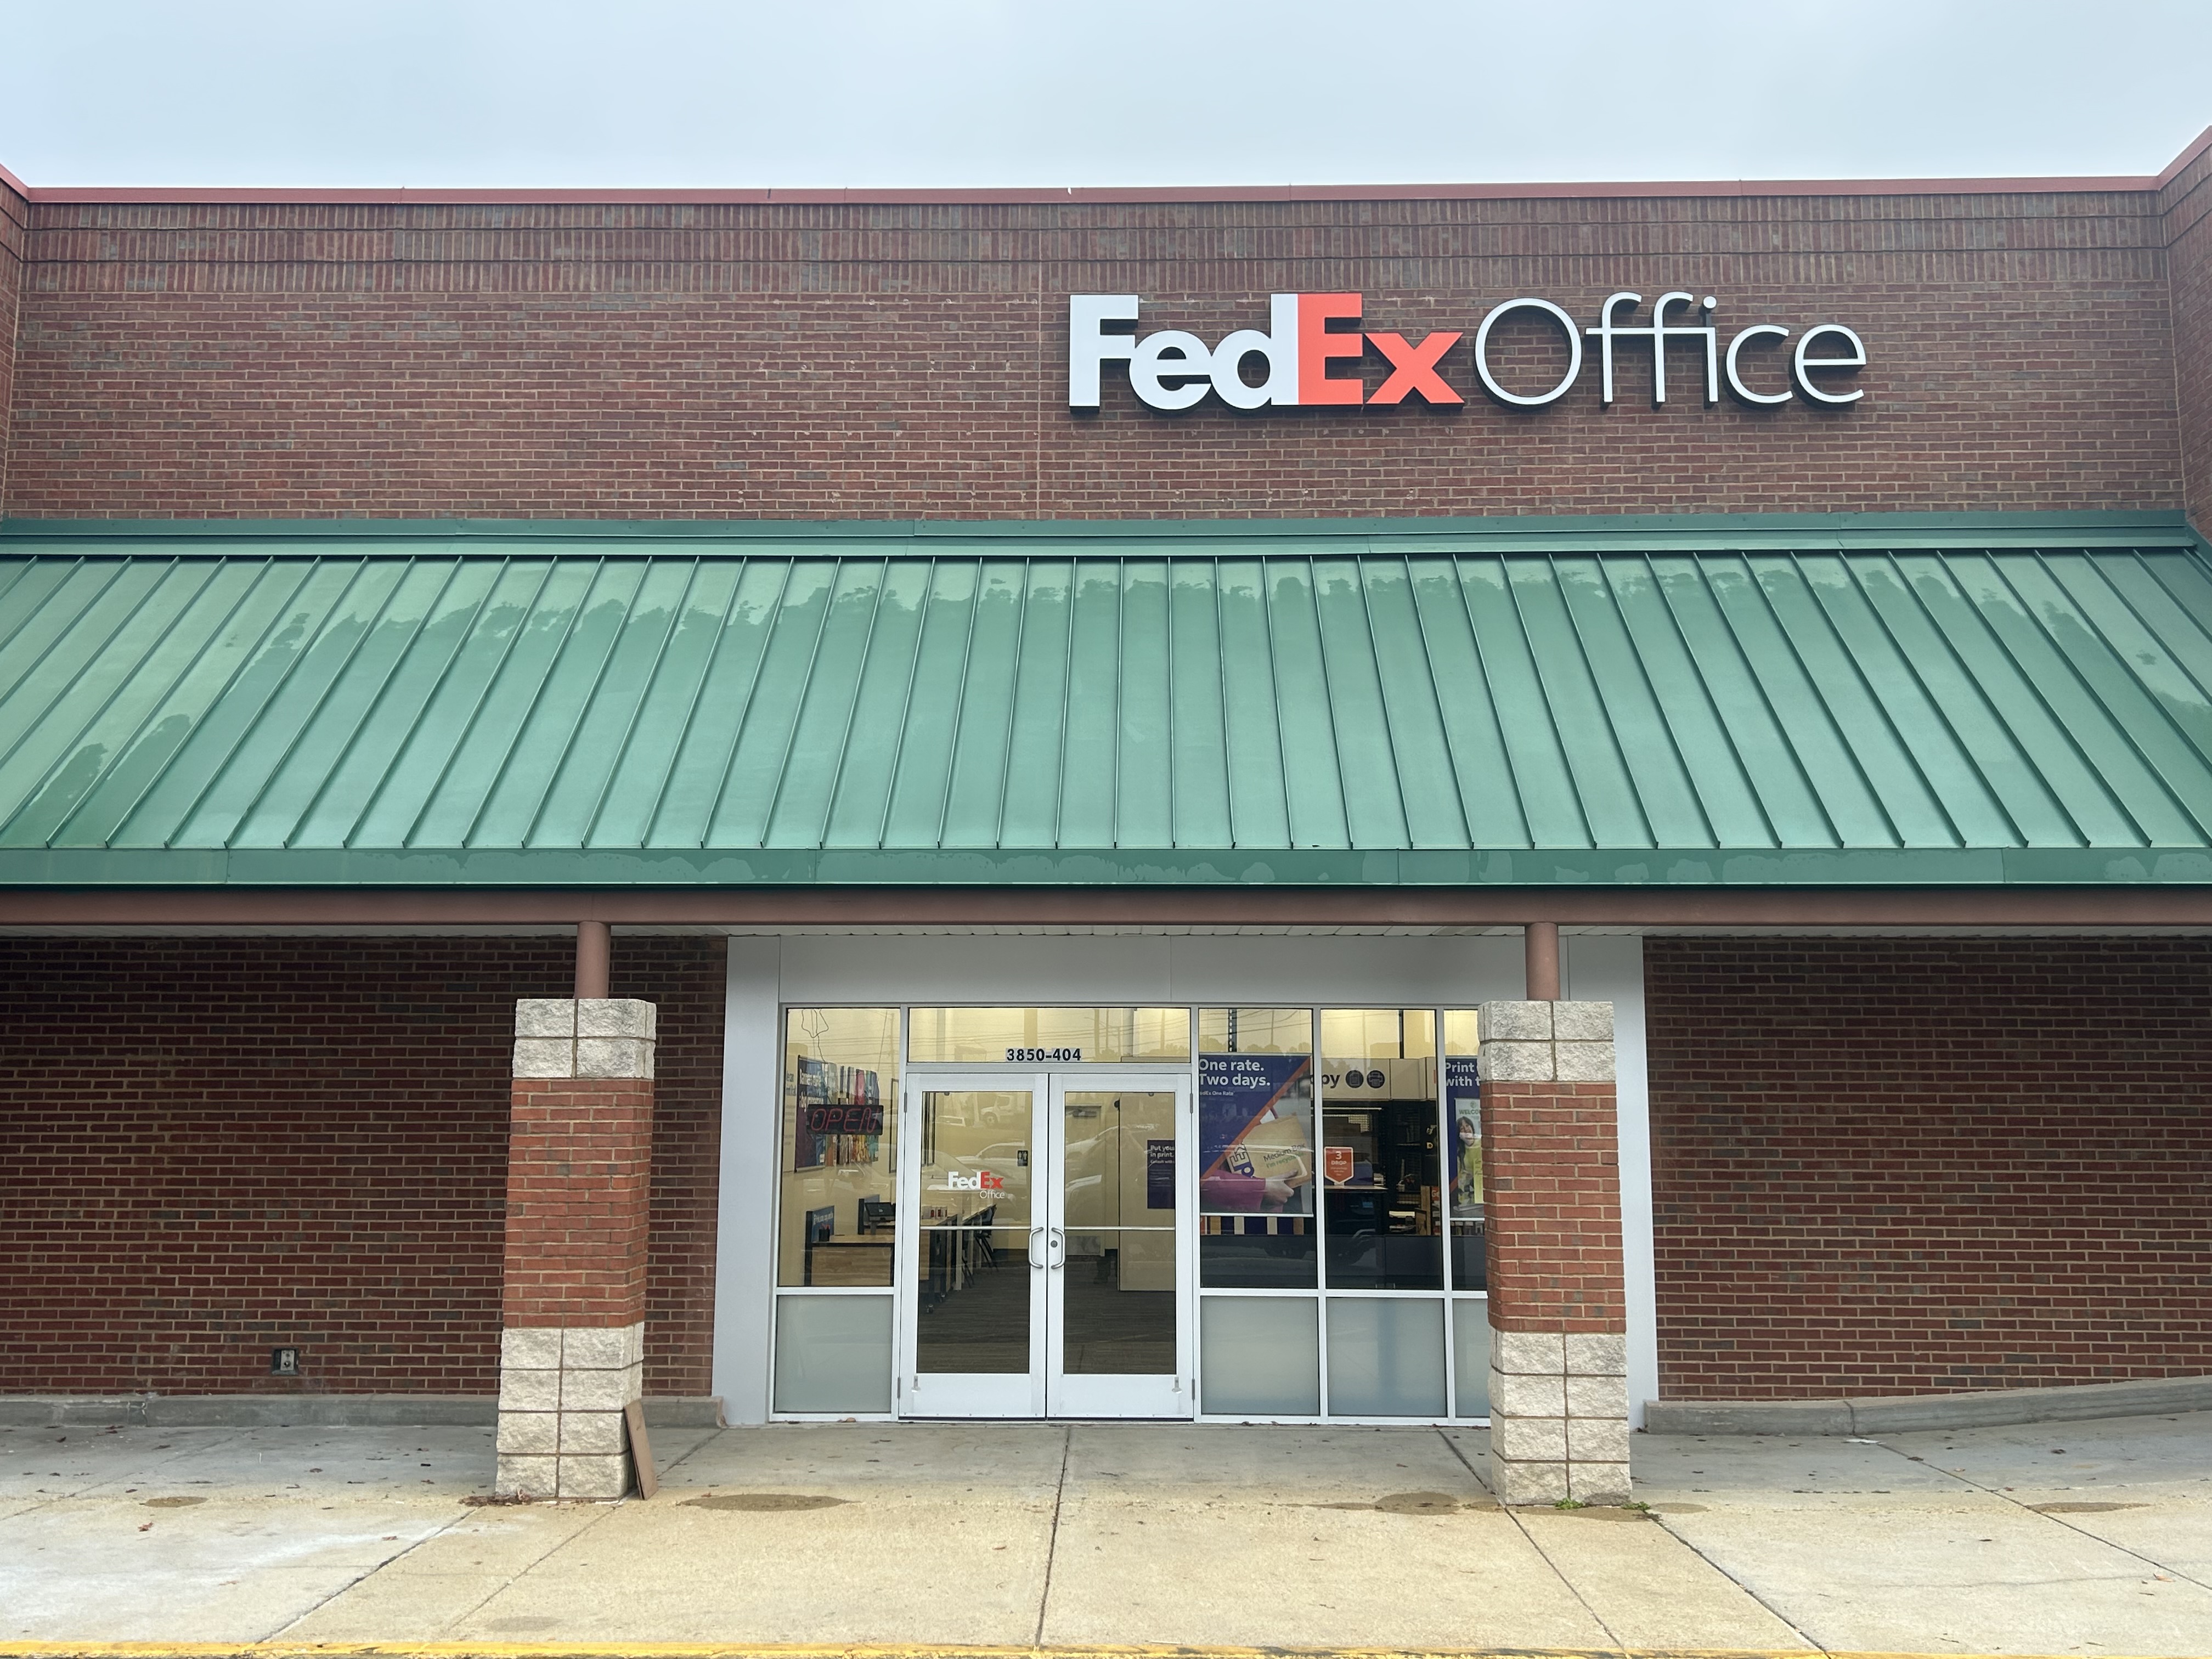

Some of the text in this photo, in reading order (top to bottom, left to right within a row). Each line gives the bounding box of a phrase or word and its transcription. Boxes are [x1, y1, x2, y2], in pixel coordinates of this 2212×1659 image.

[1069, 291, 1866, 410] FedEx Office
[1007, 1048, 1081, 1061] 3850-404
[1199, 1059, 1264, 1071] One rate.
[1446, 1062, 1475, 1073] Print
[1199, 1074, 1271, 1088] Two days.
[1446, 1076, 1472, 1086] with
[811, 1107, 880, 1133] OPEN
[1335, 1151, 1342, 1160] 3
[948, 1171, 1004, 1189] FedEx
[979, 1190, 1005, 1199] Office
